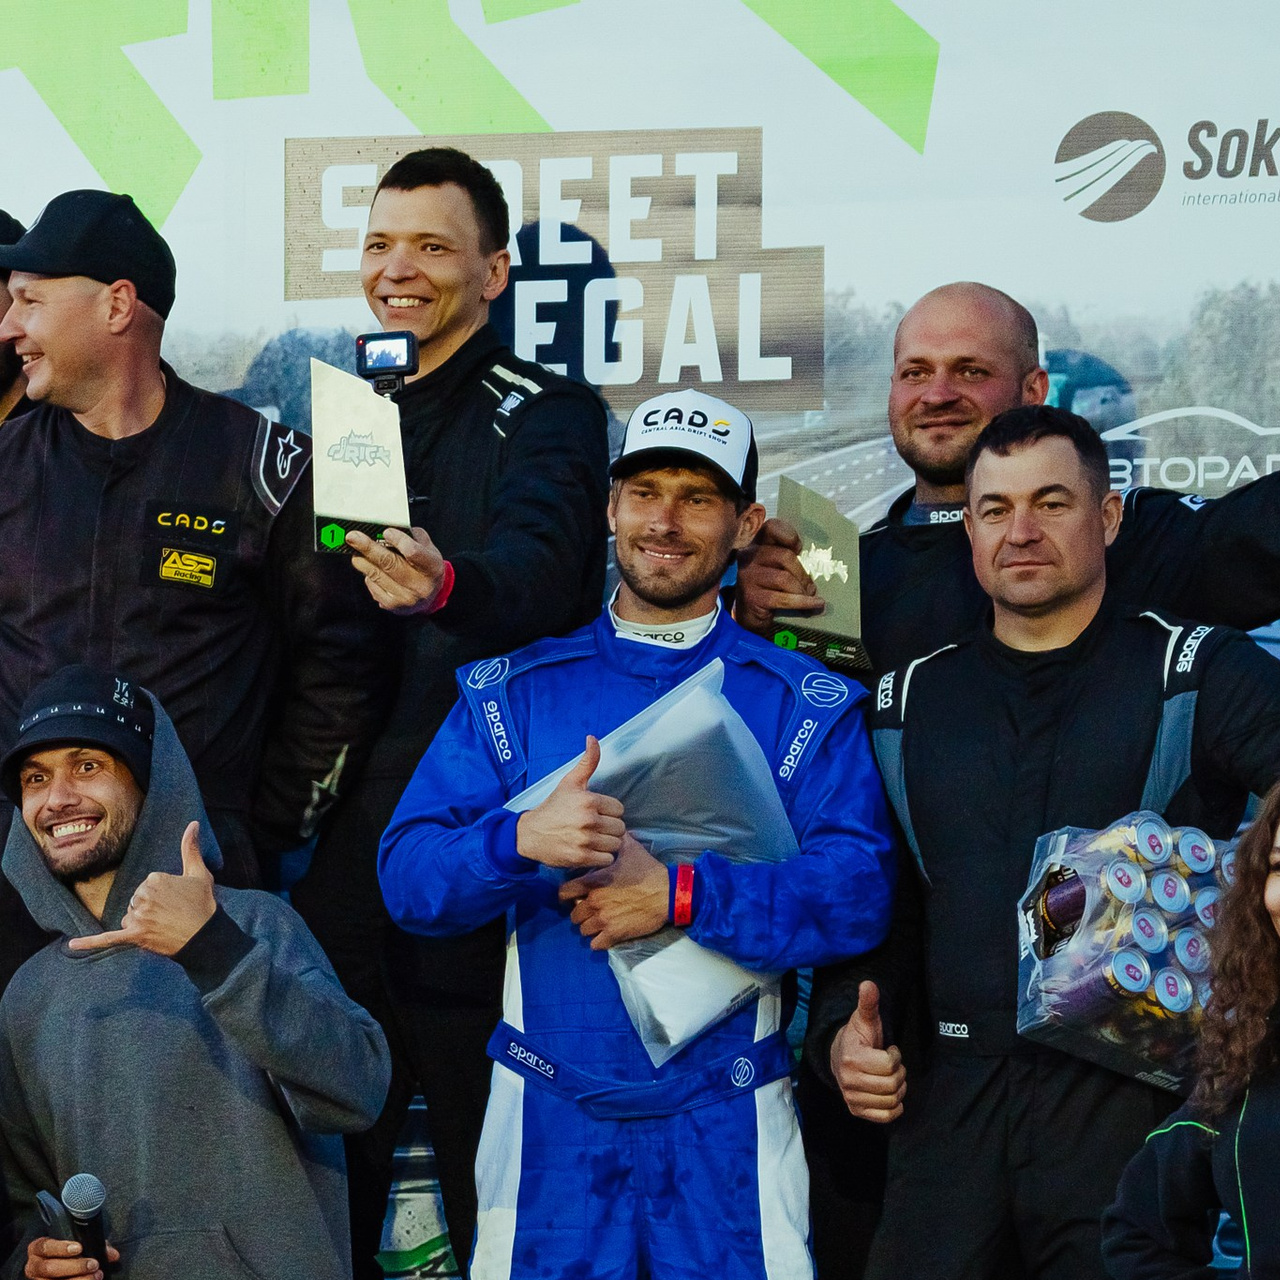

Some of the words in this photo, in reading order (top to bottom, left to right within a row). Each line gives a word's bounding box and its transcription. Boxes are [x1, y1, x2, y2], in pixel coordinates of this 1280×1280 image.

[321, 151, 738, 273] SREET
[515, 272, 793, 386] EGAL
[687, 428, 707, 438] DRIFT
[1109, 454, 1280, 490] ВТОРА
[633, 631, 685, 643] arco
